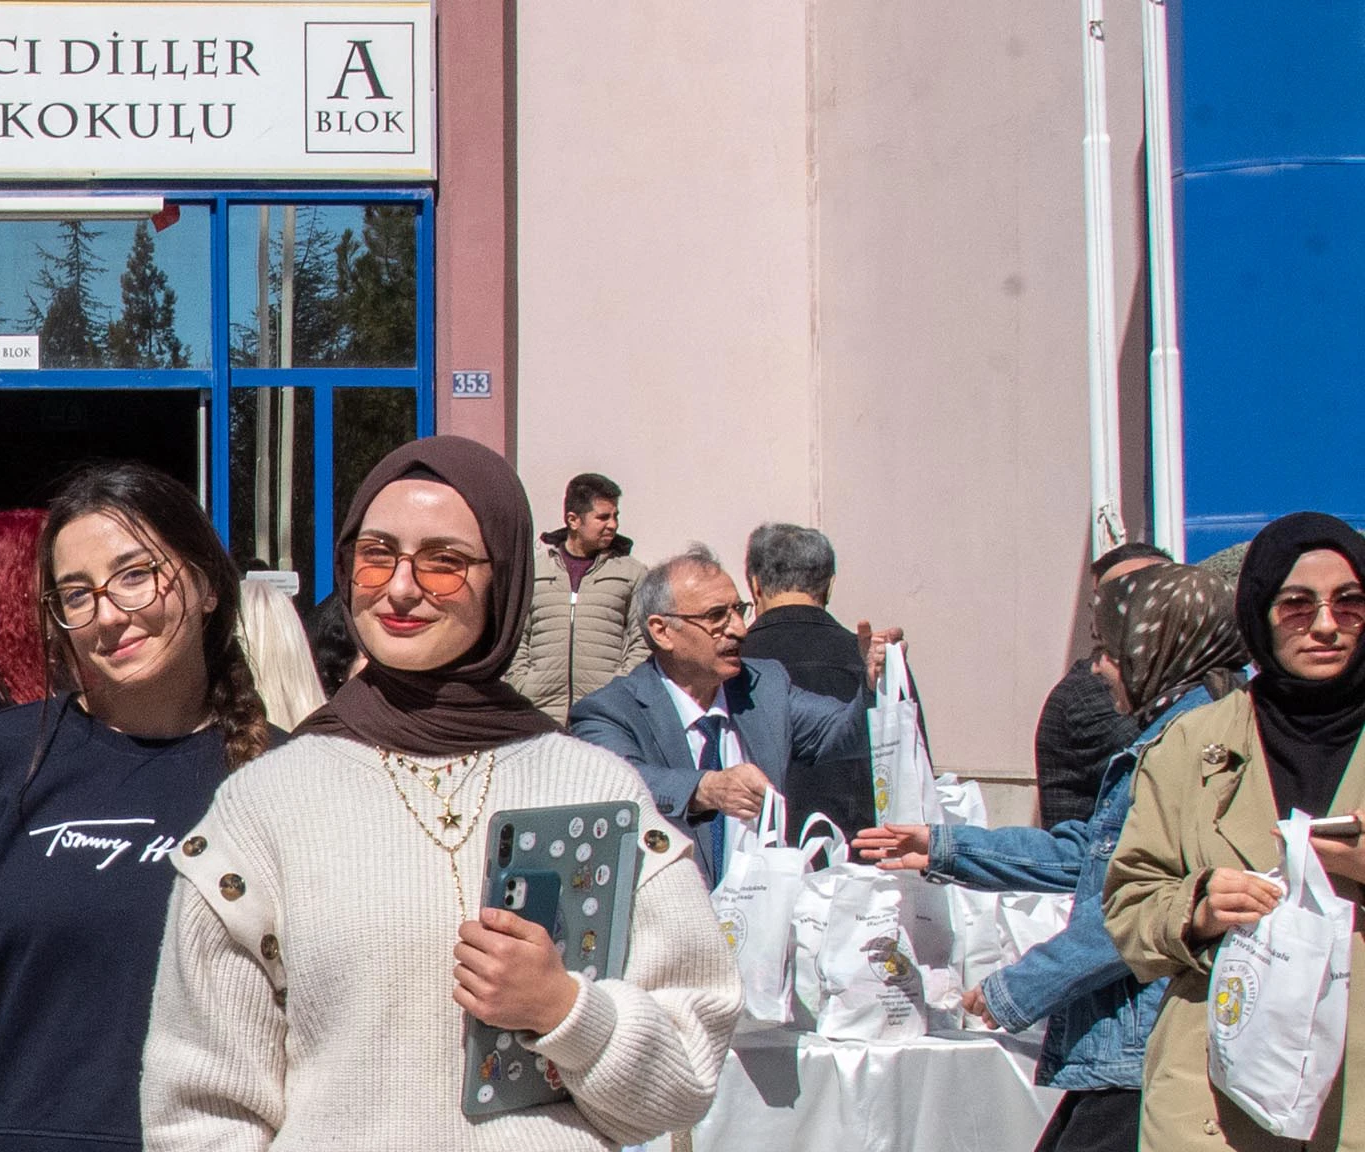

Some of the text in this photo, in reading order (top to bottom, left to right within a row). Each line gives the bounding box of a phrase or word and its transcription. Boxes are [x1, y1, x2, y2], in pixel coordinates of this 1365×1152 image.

[59, 31, 261, 80] DİLLER
[327, 40, 393, 100] A
[314, 110, 405, 136] BLOK
[2, 347, 31, 358] BLOK
[455, 374, 488, 393] 353
[29, 818, 156, 871] Tommy
